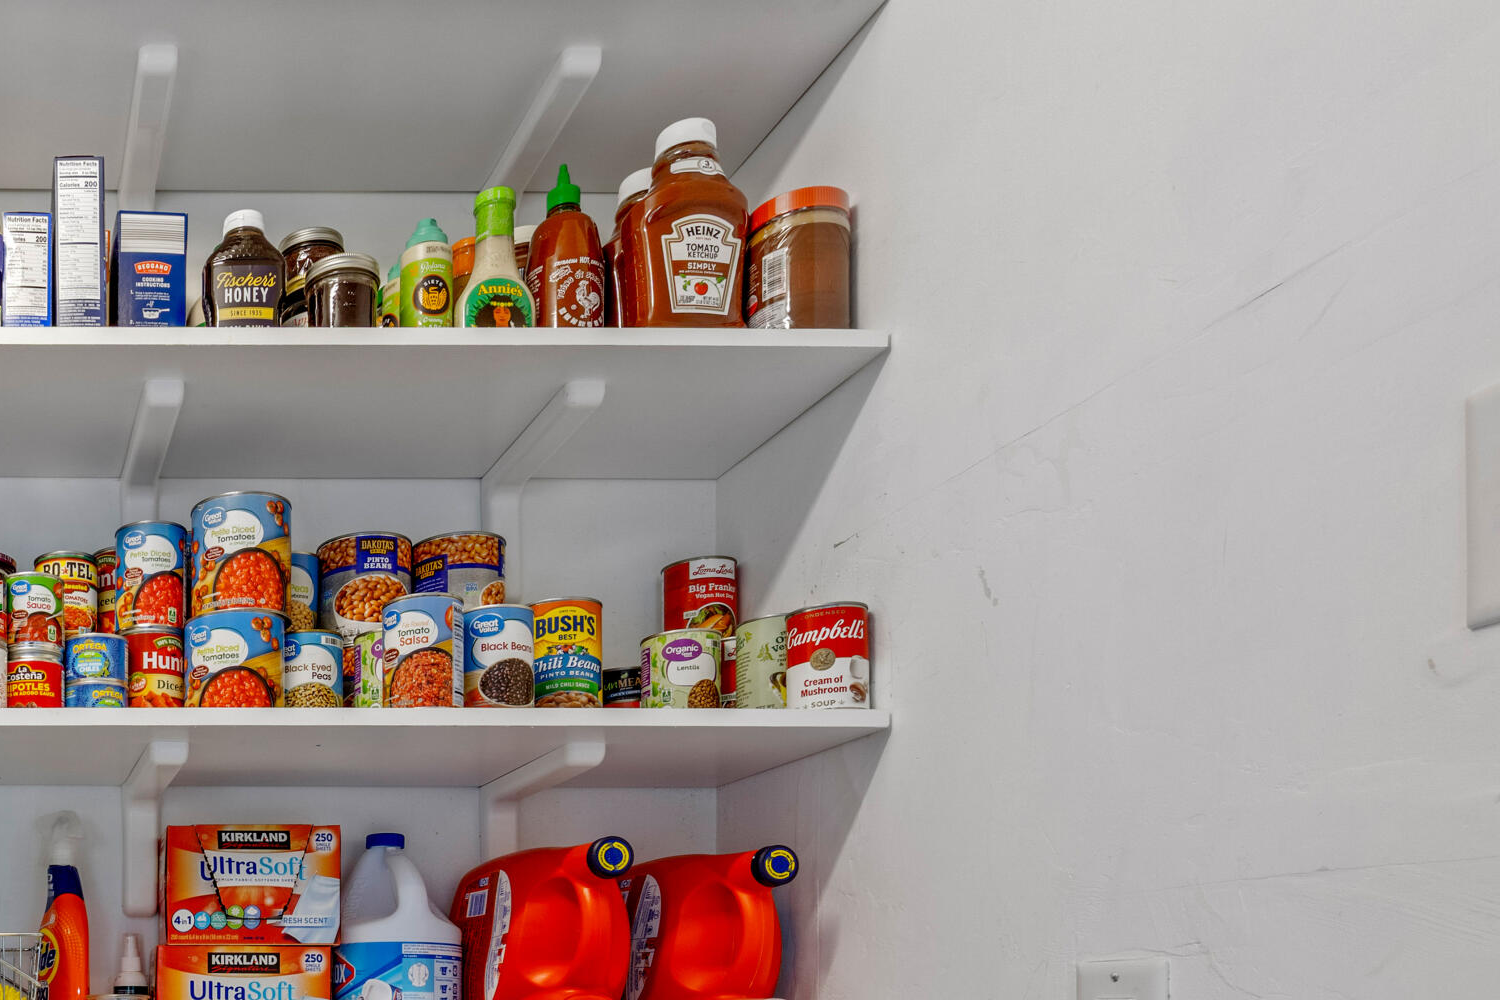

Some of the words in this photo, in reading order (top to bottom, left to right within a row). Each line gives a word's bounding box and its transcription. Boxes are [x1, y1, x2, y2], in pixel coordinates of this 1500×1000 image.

[83, 180, 97, 188] 200
[686, 225, 722, 240] HEINZ
[685, 243, 720, 254] TOMATO
[687, 251, 719, 260] KETCHUP
[687, 261, 717, 272] SIMPLY
[216, 272, 277, 289] Fischer's
[224, 286, 269, 304] HONEY
[477, 283, 524, 298] Annie's
[230, 309, 248, 317] SINCE
[204, 512, 222, 522] Great
[231, 525, 256, 535] Diced
[124, 534, 143, 544] Great
[216, 533, 256, 544] Tomatoes
[361, 540, 395, 551] DAKOTA'S
[366, 556, 390, 564] PINTO
[66, 561, 93, 580] TEL
[363, 562, 393, 570] BEANS
[688, 584, 707, 594] Big
[708, 582, 736, 593] Franks
[27, 595, 52, 603] Tomato
[26, 601, 52, 610] Sauce
[473, 619, 499, 629] Great
[479, 625, 499, 633] Value
[535, 614, 596, 640] BUSH'S
[191, 632, 207, 642] Great
[397, 626, 431, 637] Tomato
[558, 633, 577, 641] BEST
[787, 618, 865, 650] Campbell's
[72, 641, 108, 653] ORTEGA
[399, 636, 430, 647] Salsa
[480, 641, 509, 652] Black
[215, 644, 240, 655] Diced
[665, 643, 700, 657] Organic
[202, 653, 240, 663] Tomatoes
[284, 662, 308, 673] Black
[311, 663, 332, 674] Eyed
[534, 657, 562, 674] Chili
[566, 658, 601, 673] Beans
[676, 664, 701, 672] Lentils
[311, 671, 332, 681] Peas
[540, 671, 566, 680] PINTO
[568, 671, 594, 679] BEANS
[803, 677, 833, 688] Cream
[833, 675, 844, 684] of
[91, 690, 124, 700] ORTEGA
[800, 684, 848, 698] Mushroom
[810, 698, 837, 709] SOUP
[221, 832, 288, 843] KIRKLAND
[315, 833, 333, 843] 250
[308, 916, 328, 924] SCENT
[211, 954, 278, 966] KIRKLAND
[304, 953, 323, 963] 250
